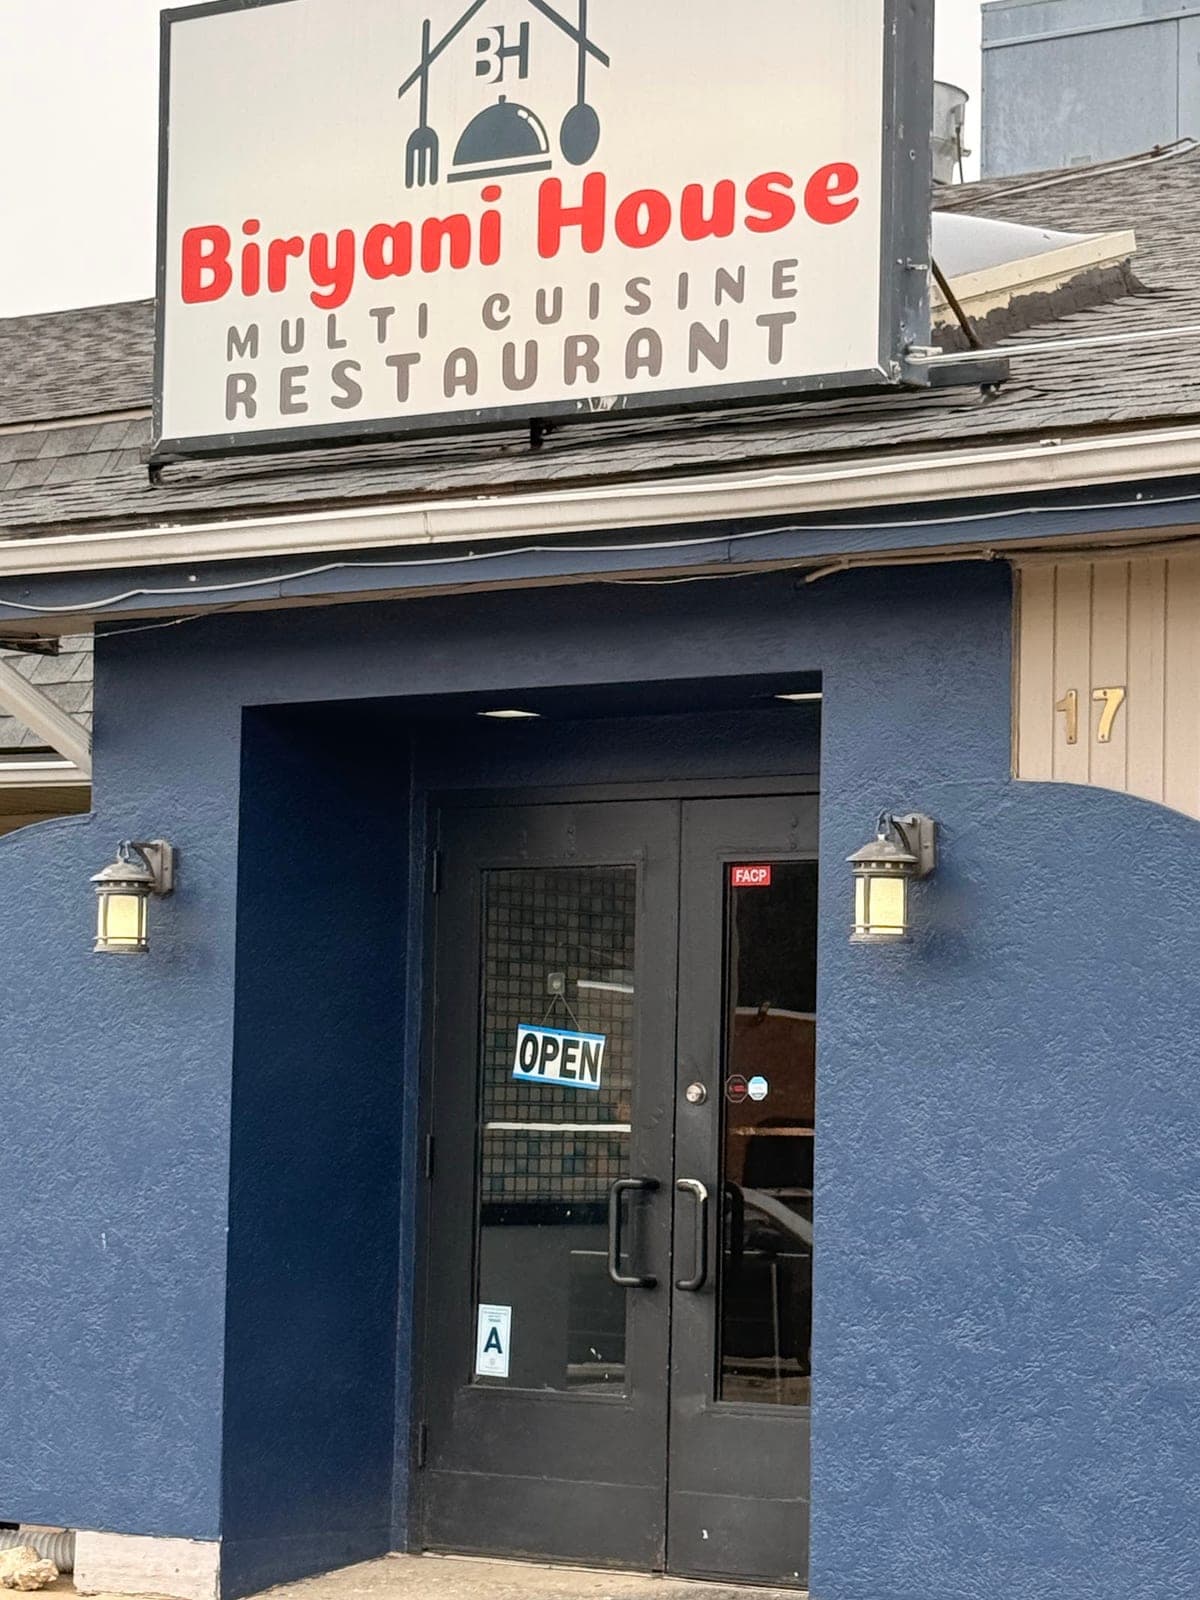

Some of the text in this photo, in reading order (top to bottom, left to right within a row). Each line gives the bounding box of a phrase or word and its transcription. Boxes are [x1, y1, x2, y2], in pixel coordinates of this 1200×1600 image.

[181, 161, 860, 310] Biryani House
[226, 258, 798, 362] MULTI CUISINE
[225, 311, 797, 420] RESTAURANT
[1056, 686, 1127, 745] 17
[735, 868, 768, 883] FACP
[519, 1032, 602, 1083] OPEN
[483, 1326, 503, 1354] A
